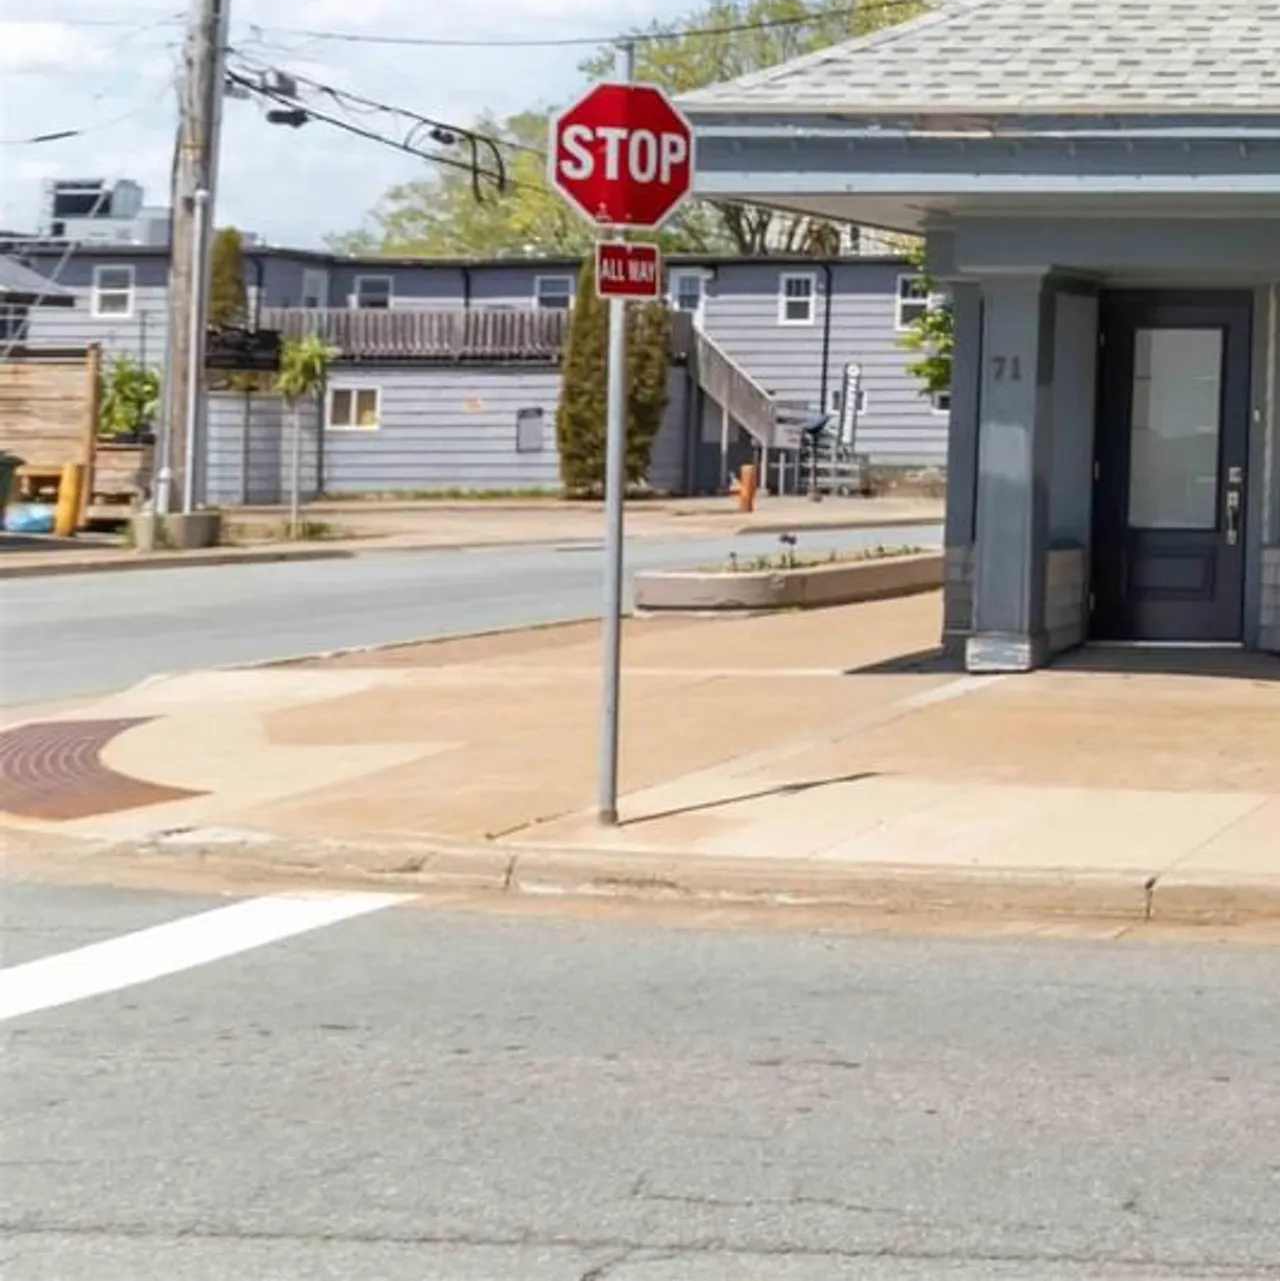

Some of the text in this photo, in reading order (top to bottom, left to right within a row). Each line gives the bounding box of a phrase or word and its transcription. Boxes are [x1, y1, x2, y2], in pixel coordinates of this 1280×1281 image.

[560, 124, 687, 185] STOP
[600, 258, 655, 282] ALL WAY
[991, 355, 1022, 381] 71
